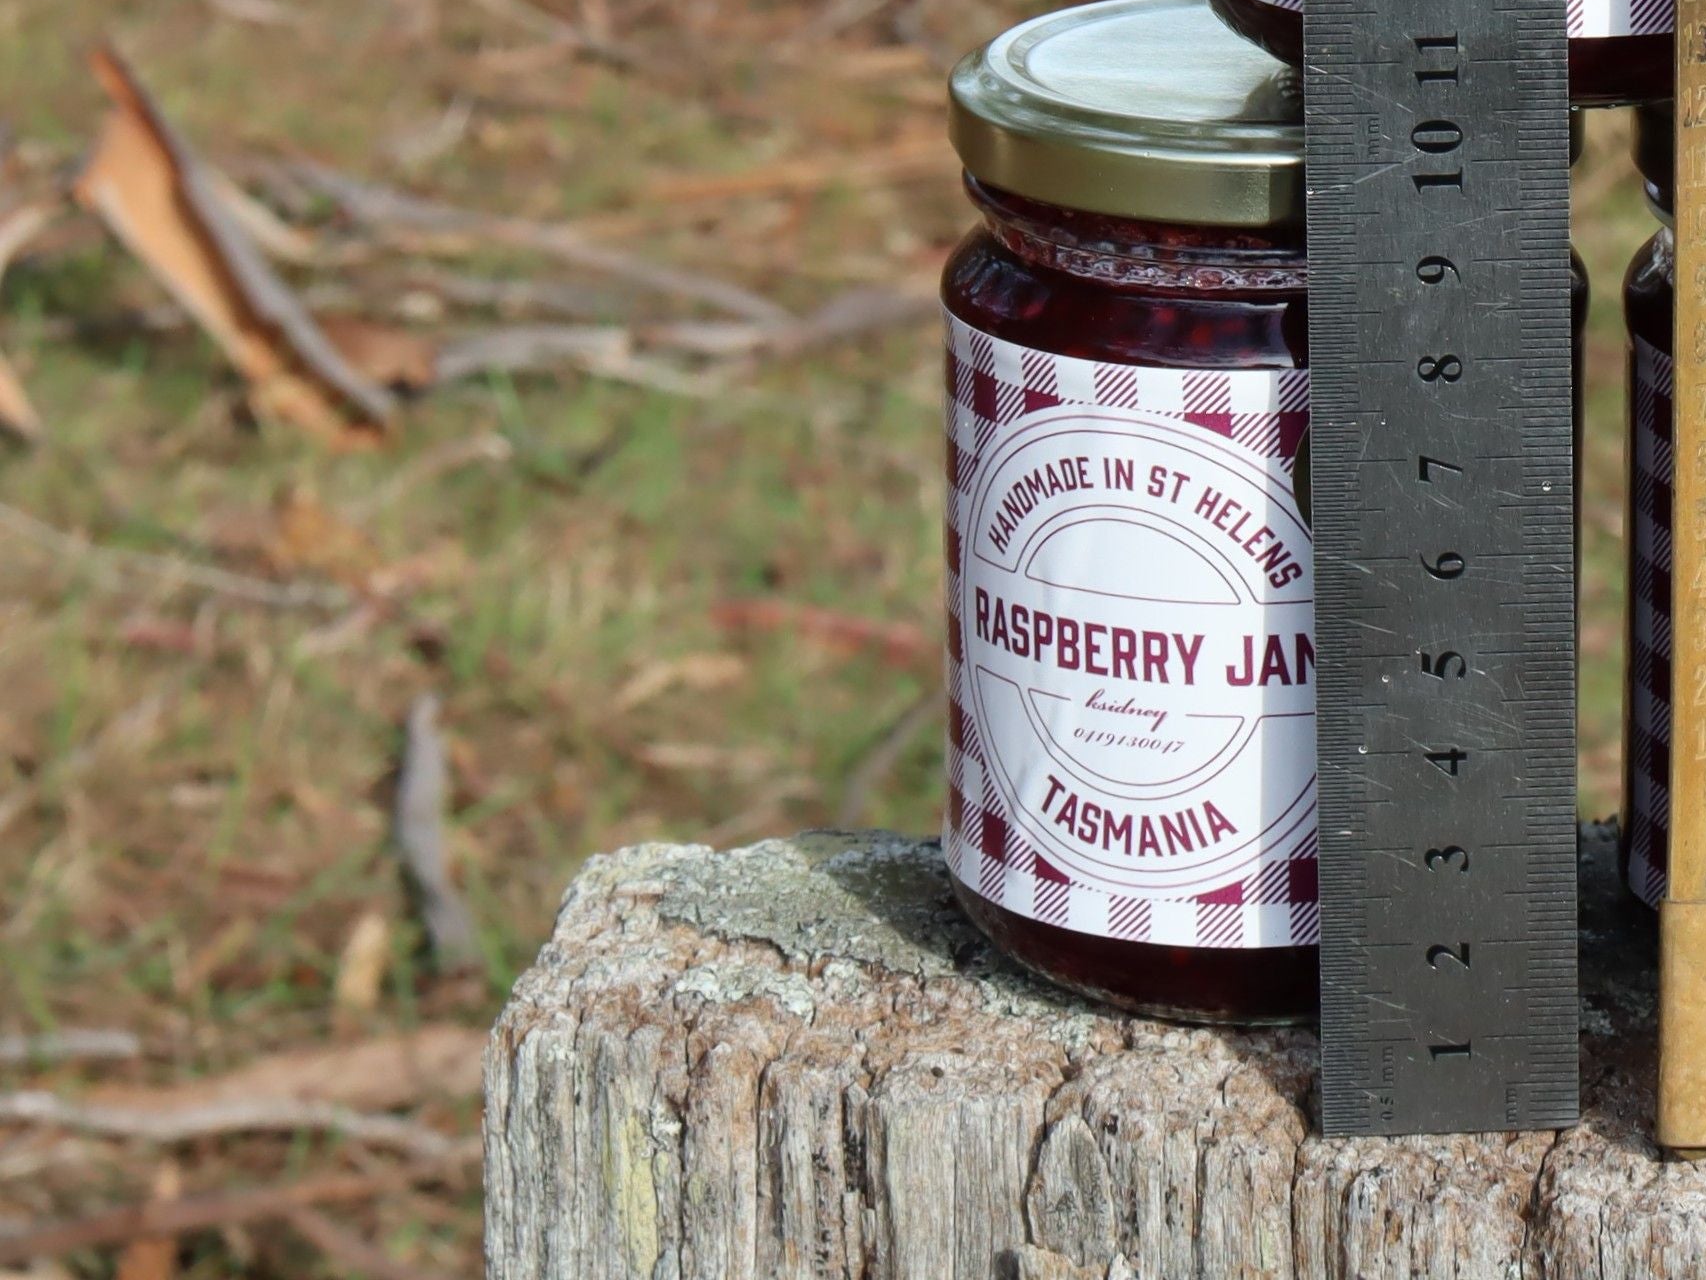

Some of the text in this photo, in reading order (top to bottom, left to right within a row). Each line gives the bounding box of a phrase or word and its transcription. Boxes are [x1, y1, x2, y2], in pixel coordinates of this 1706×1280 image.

[1412, 31, 1460, 89] 11
[1410, 119, 1464, 195] 10
[1415, 255, 1461, 285] 9
[1416, 353, 1463, 384] 8
[1418, 455, 1464, 485] 7
[988, 457, 1303, 590] HANDMADE IN ST HELENS
[1420, 551, 1466, 581] 6
[975, 585, 1206, 687] RASPBERRY
[1420, 649, 1467, 681] 5
[1422, 746, 1467, 777] 4
[1040, 773, 1239, 857] TASMANIA
[1423, 844, 1469, 873] 3
[1425, 941, 1470, 970] 2
[1428, 1038, 1471, 1061] 1
